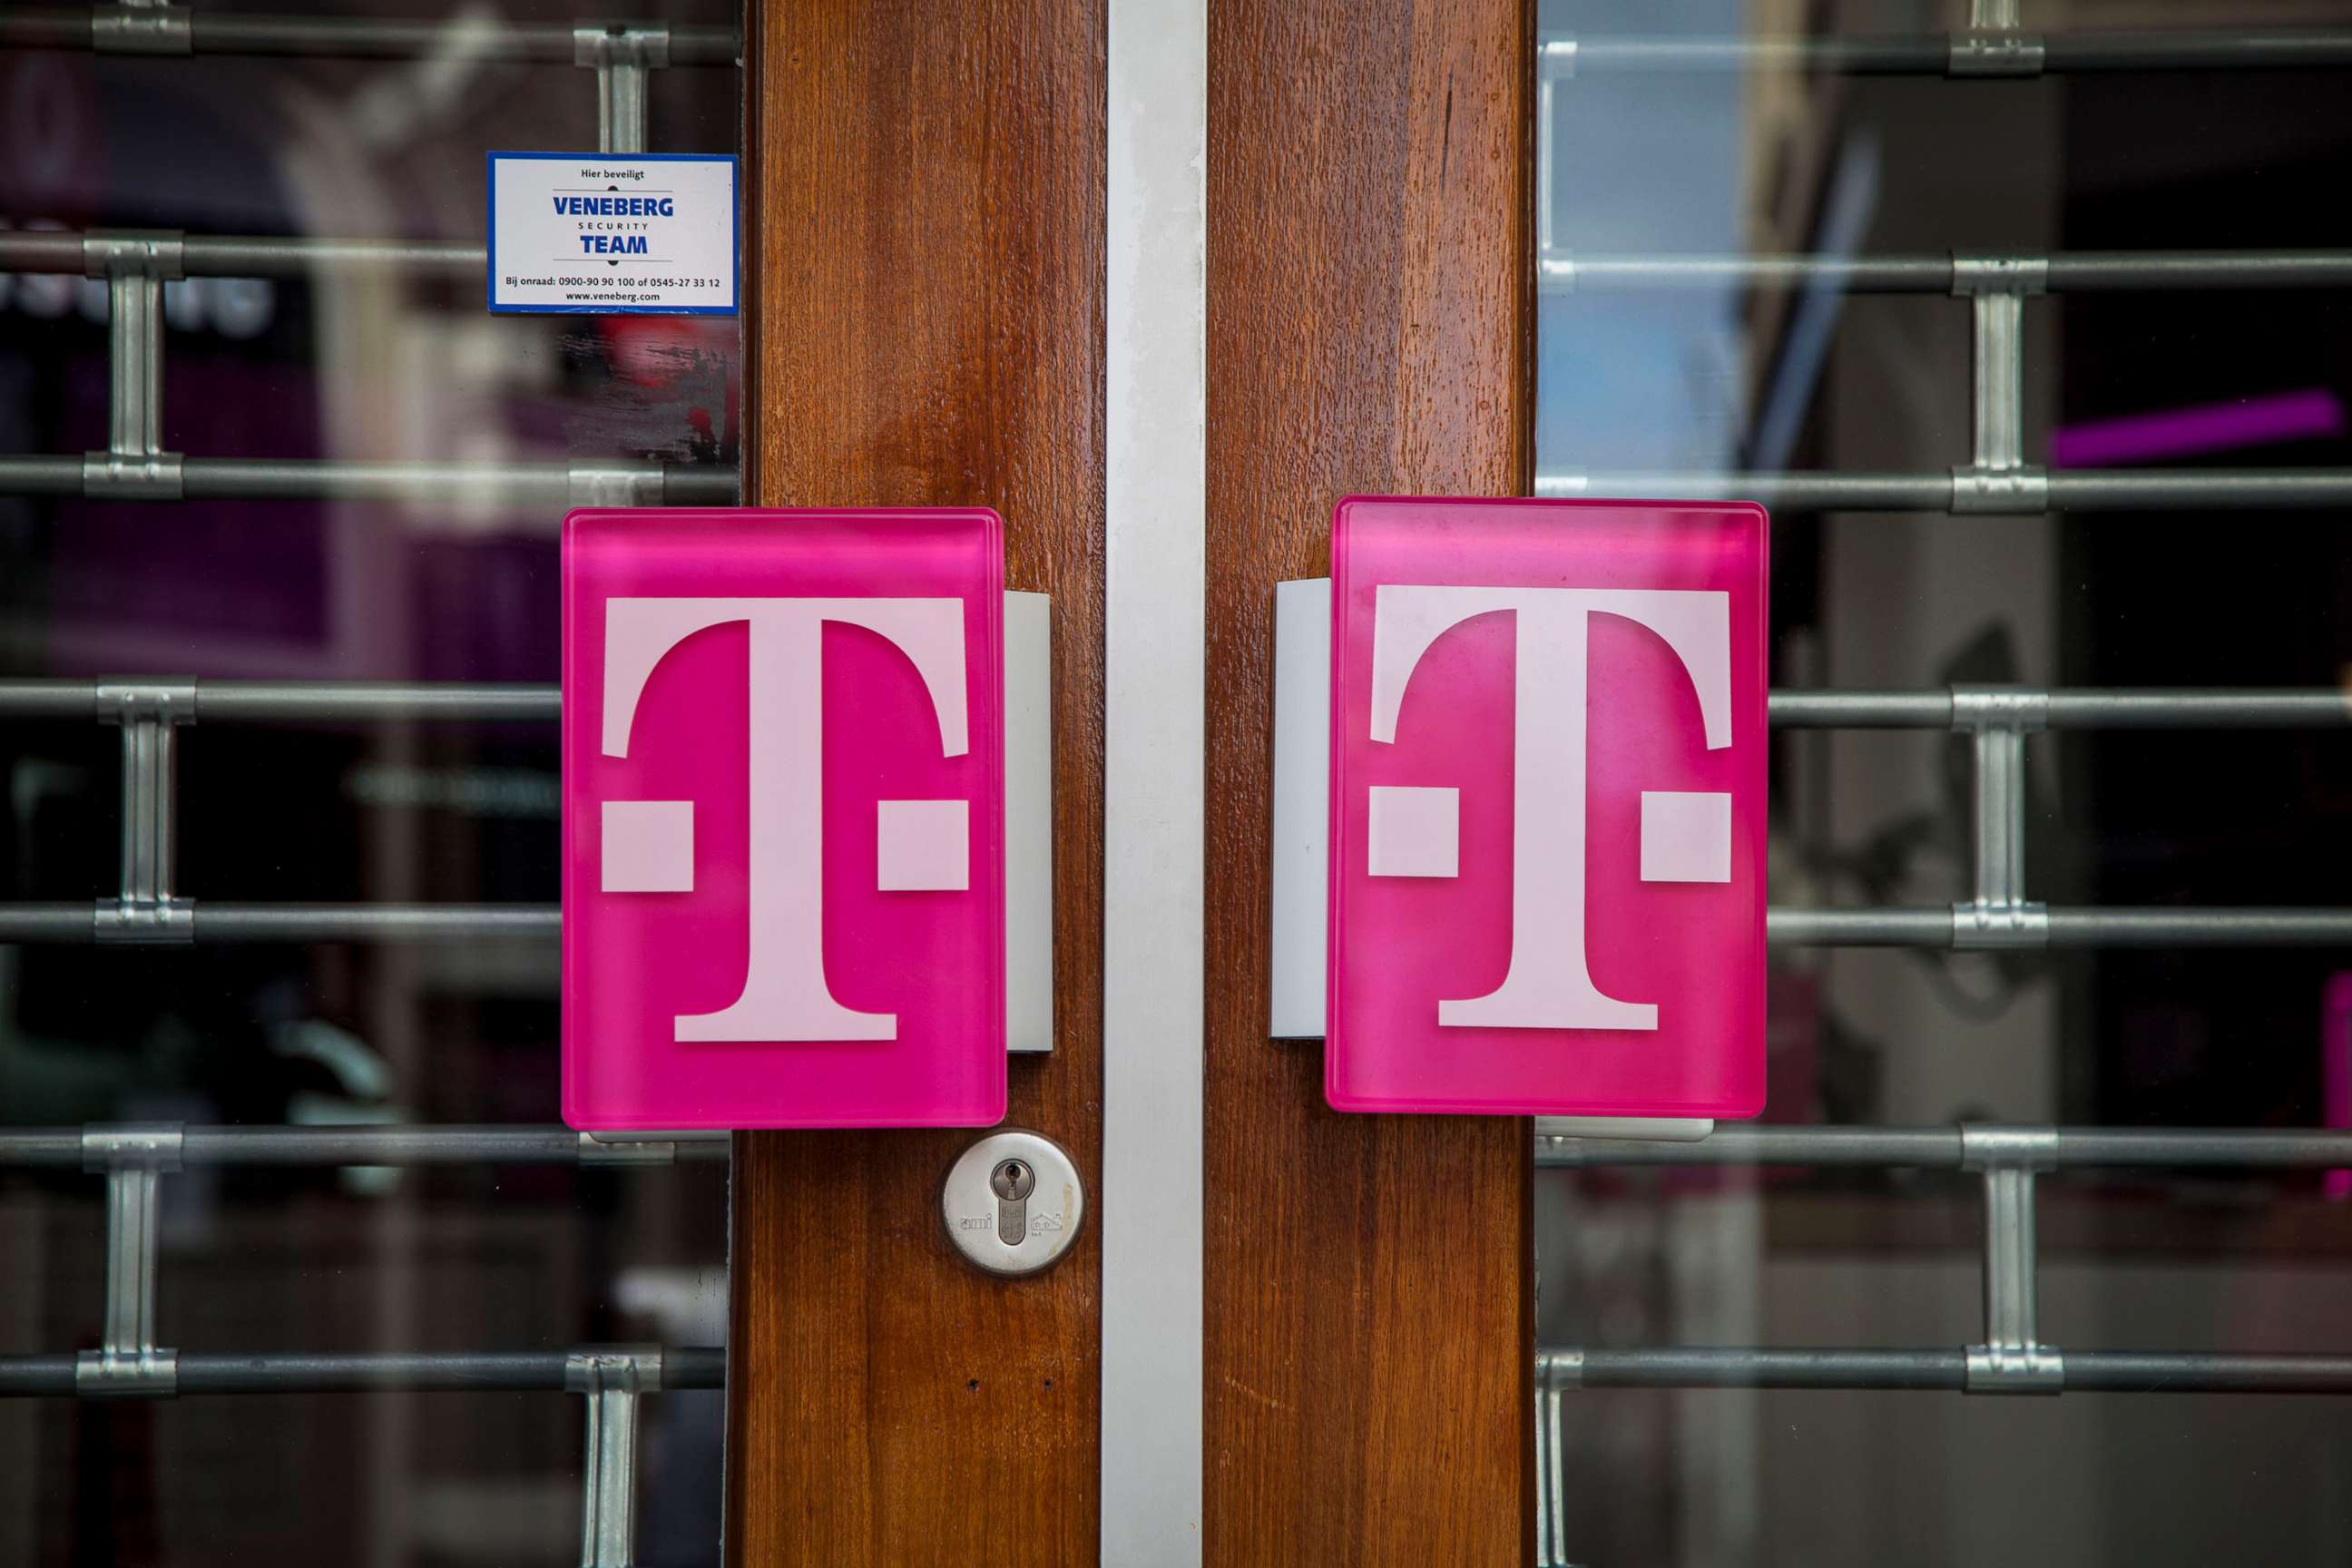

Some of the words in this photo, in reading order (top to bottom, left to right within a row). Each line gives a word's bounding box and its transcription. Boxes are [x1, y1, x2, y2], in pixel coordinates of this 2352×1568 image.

[581, 169, 601, 178] Hier
[603, 169, 644, 181] beveiligt
[553, 196, 674, 218] VENEBERG
[578, 221, 648, 230] SECURITY
[580, 235, 648, 254] TEAM
[505, 276, 518, 288] Bij
[520, 276, 556, 286] onraad:
[558, 277, 599, 286] 0900-90
[602, 277, 614, 287] 90
[617, 278, 635, 287] 100
[637, 278, 648, 287] of
[650, 278, 691, 287] 0545-27
[693, 279, 705, 288] 33
[709, 279, 720, 288] 12
[565, 291, 660, 303] www.veneberg.com
[1369, 584, 1732, 1030] T
[602, 597, 969, 1042] T
